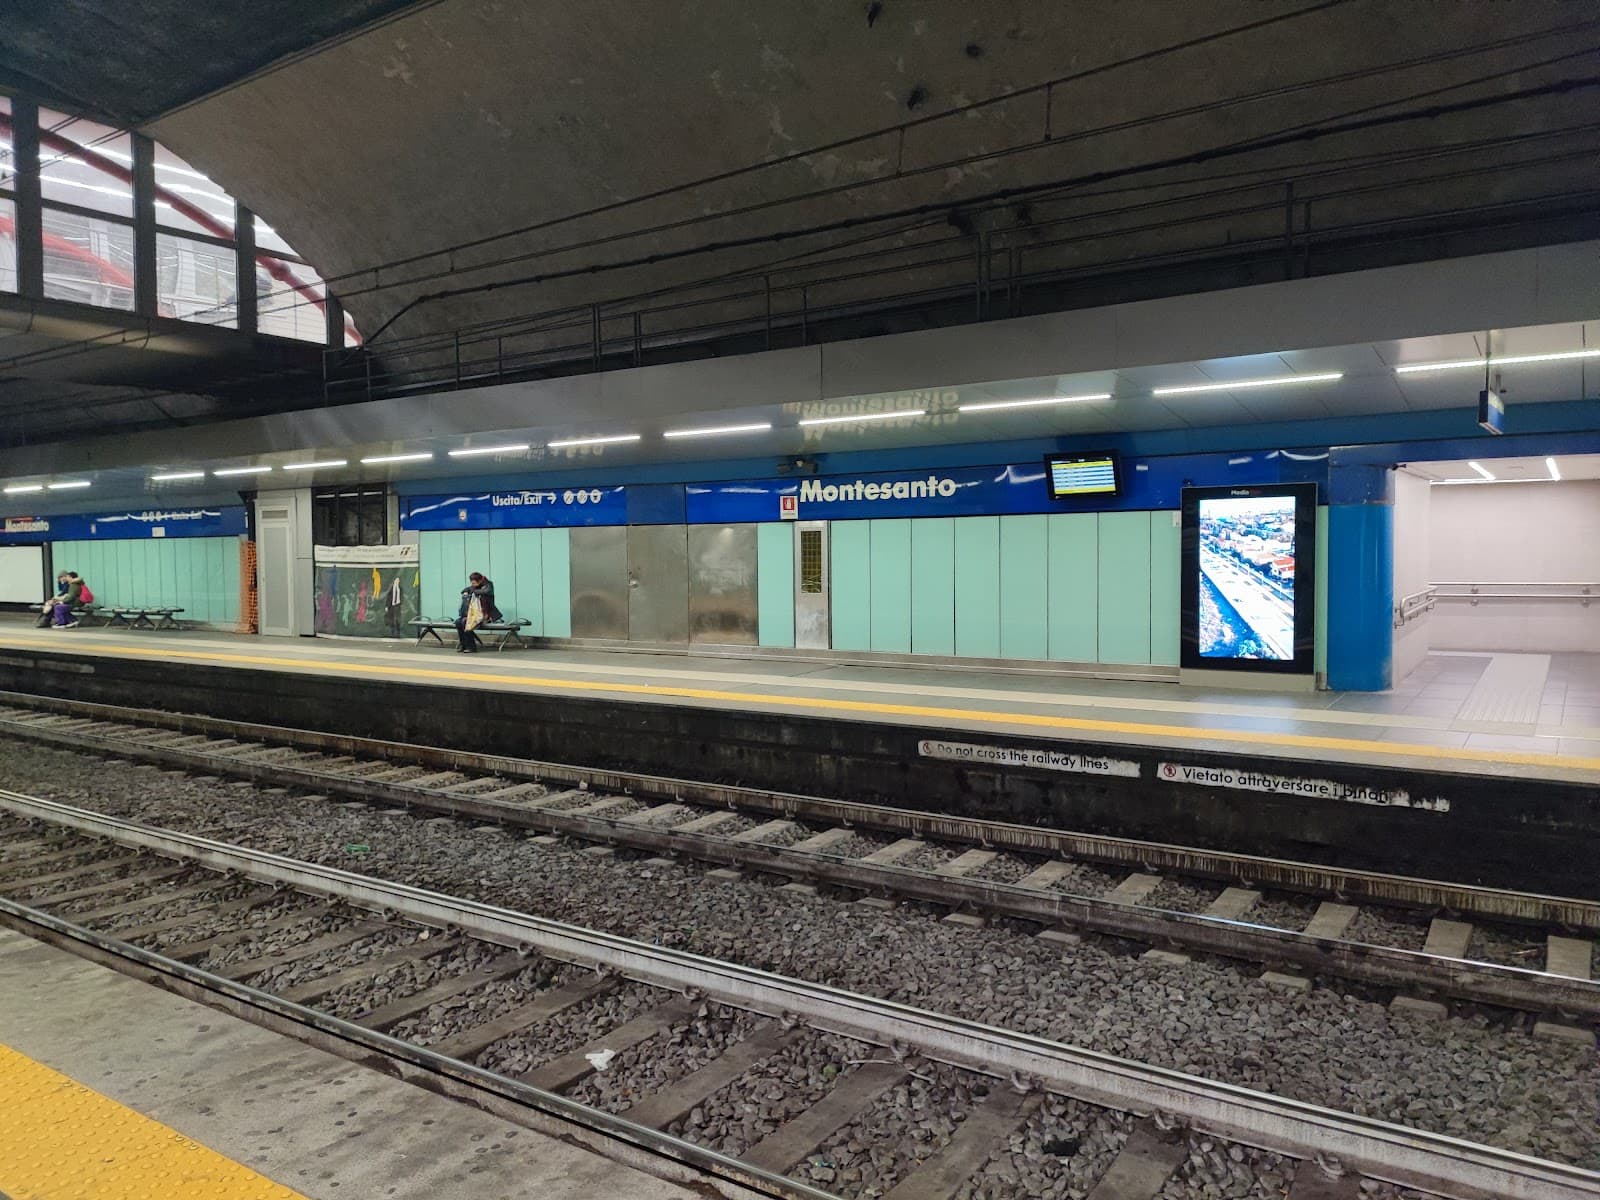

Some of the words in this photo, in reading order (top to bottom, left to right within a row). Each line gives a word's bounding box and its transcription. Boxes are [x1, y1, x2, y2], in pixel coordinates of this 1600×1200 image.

[799, 476, 957, 502] Montesanto
[937, 743, 952, 754] Do
[955, 745, 973, 757] not
[977, 748, 1007, 760] cross
[1008, 749, 1029, 762] the
[1032, 751, 1077, 769] railway
[1079, 756, 1109, 770] lines
[1182, 767, 1234, 785] Vietato
[1237, 773, 1329, 797] attraversare
